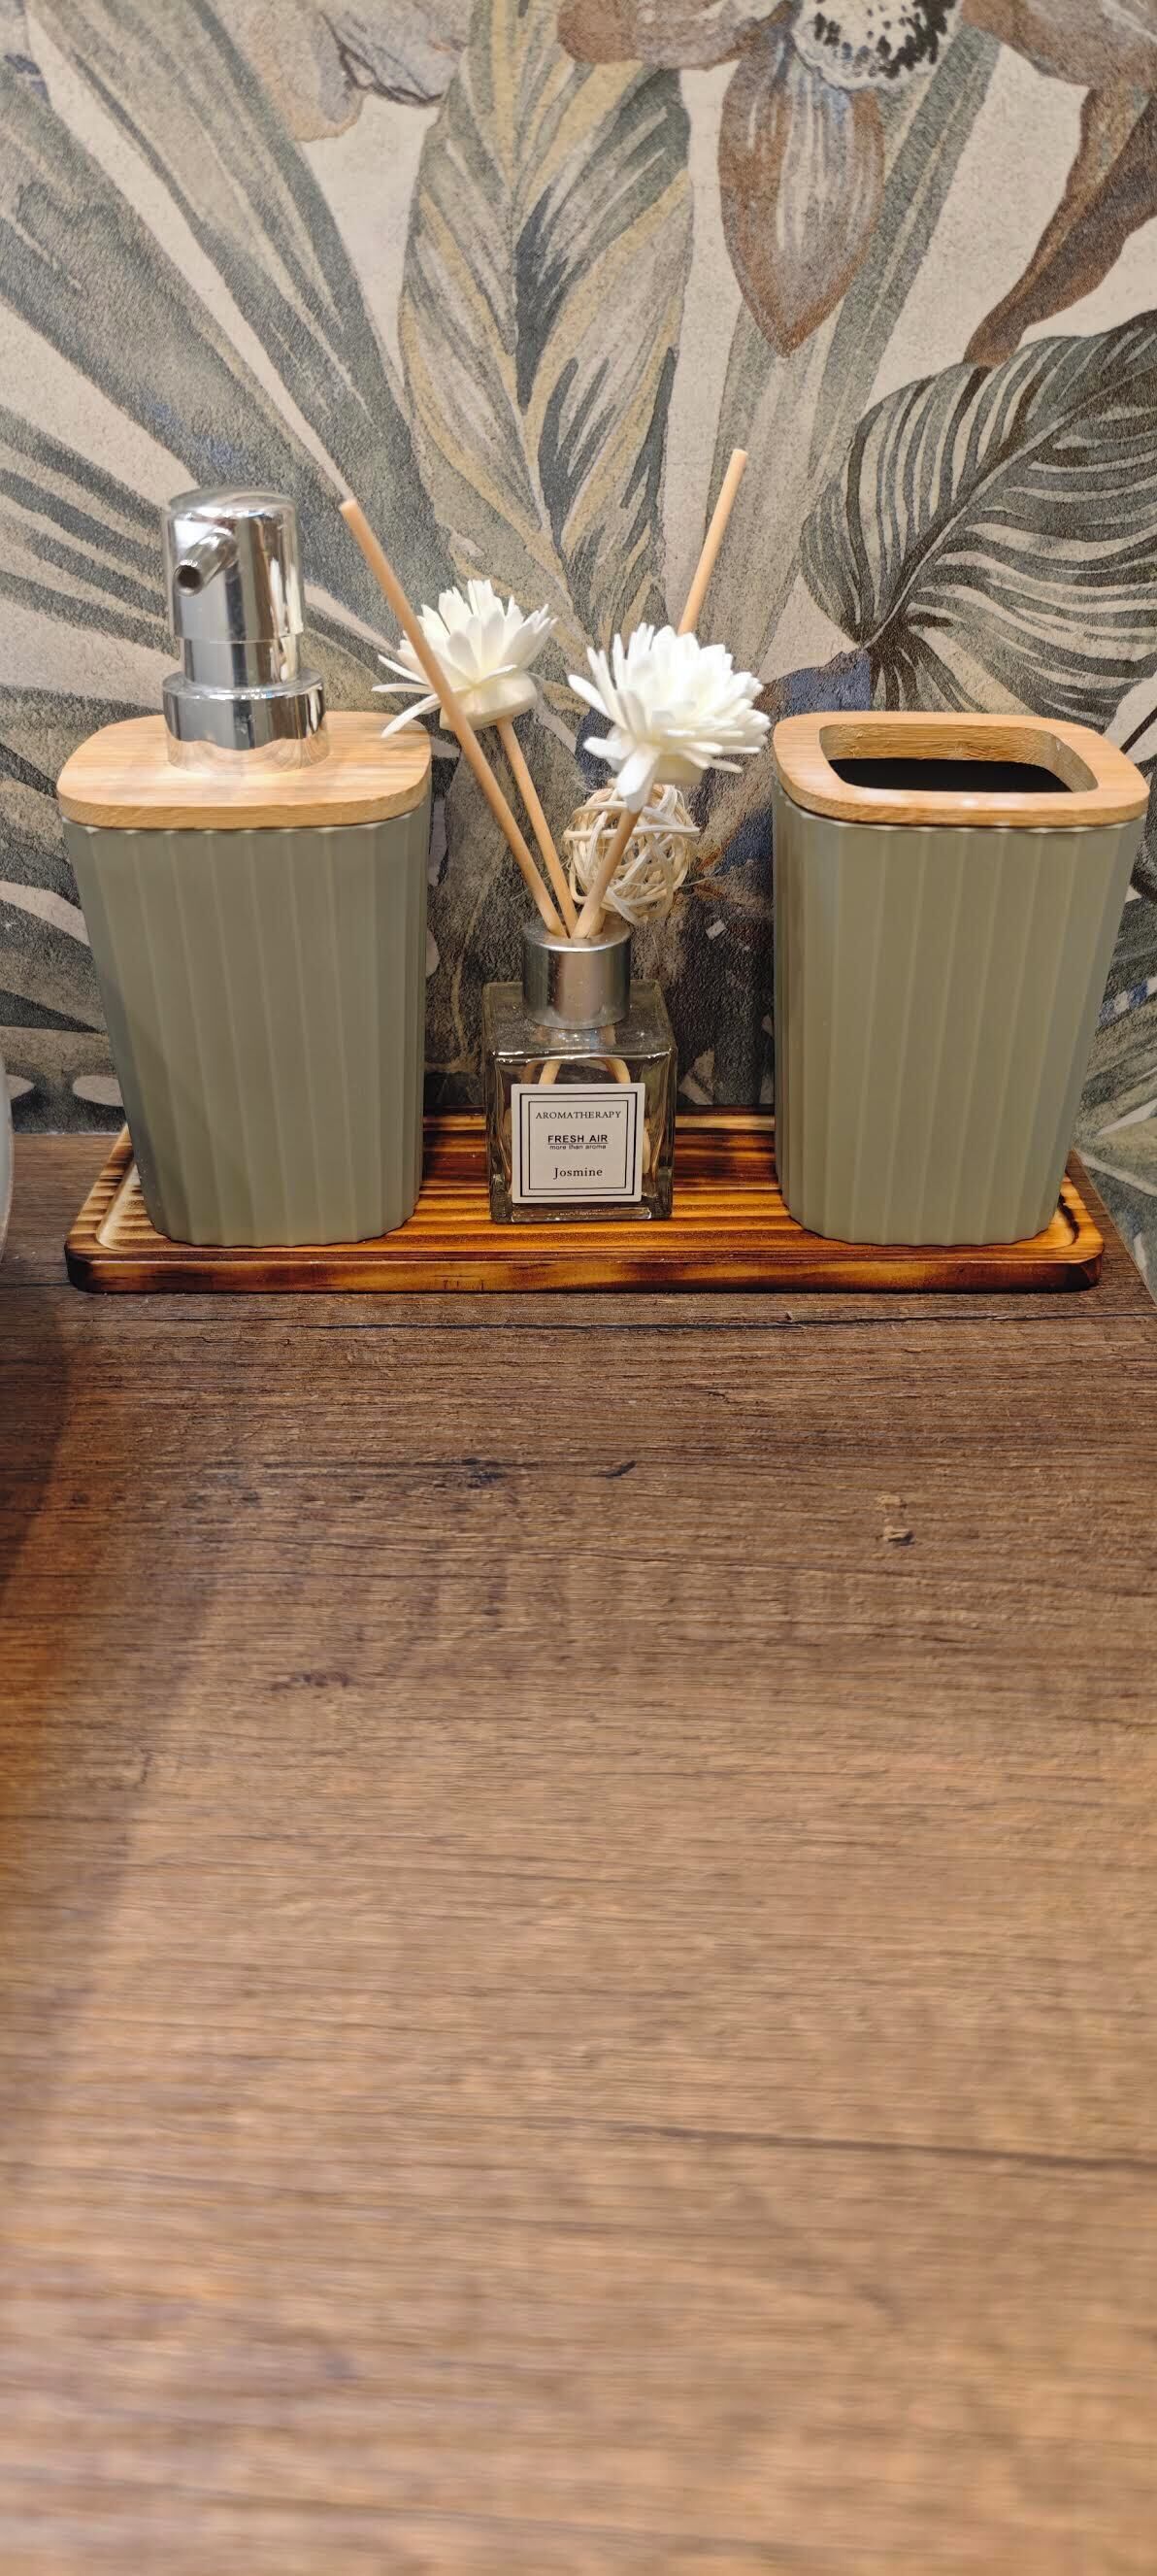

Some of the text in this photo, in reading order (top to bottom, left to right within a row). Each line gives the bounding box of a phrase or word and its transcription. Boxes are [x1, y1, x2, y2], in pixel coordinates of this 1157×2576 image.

[535, 1111, 621, 1120] AROMATHERAPY
[547, 1134, 608, 1143] FRESH AIR
[552, 1167, 603, 1180] Josmine
